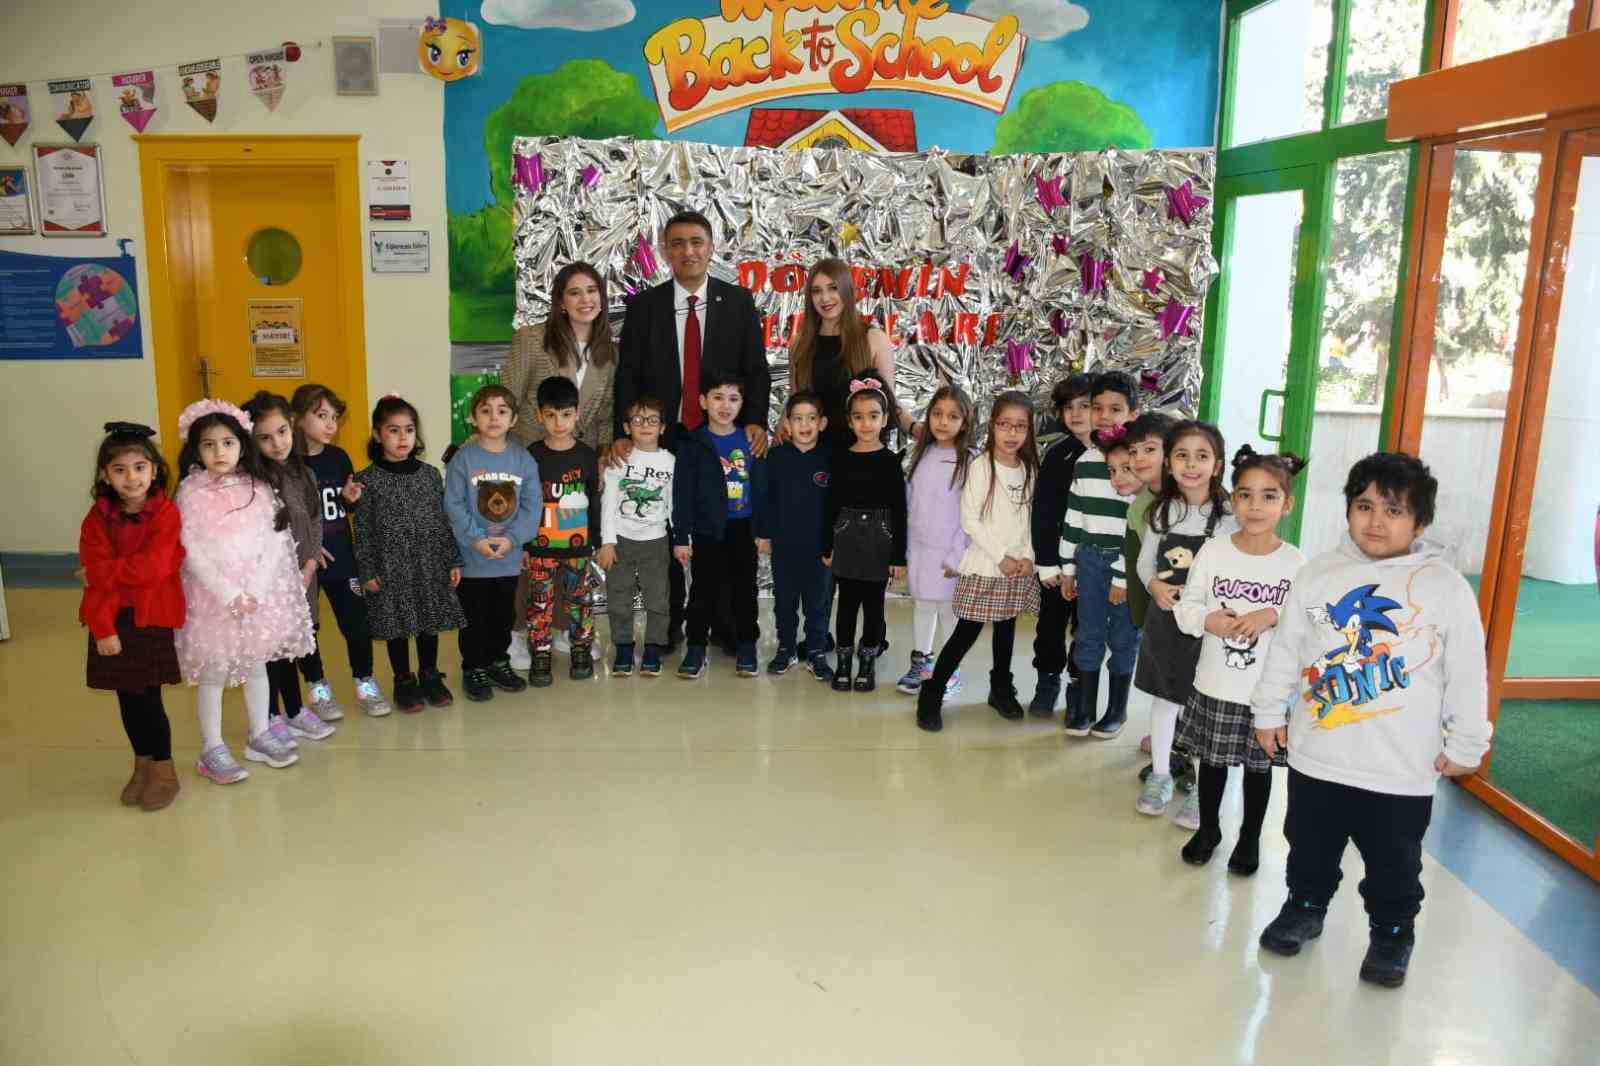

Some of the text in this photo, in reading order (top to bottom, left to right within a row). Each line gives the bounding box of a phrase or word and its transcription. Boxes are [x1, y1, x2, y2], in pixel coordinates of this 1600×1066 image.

[643, 8, 1020, 111] Back to School
[1311, 652, 1410, 719] SONIC
